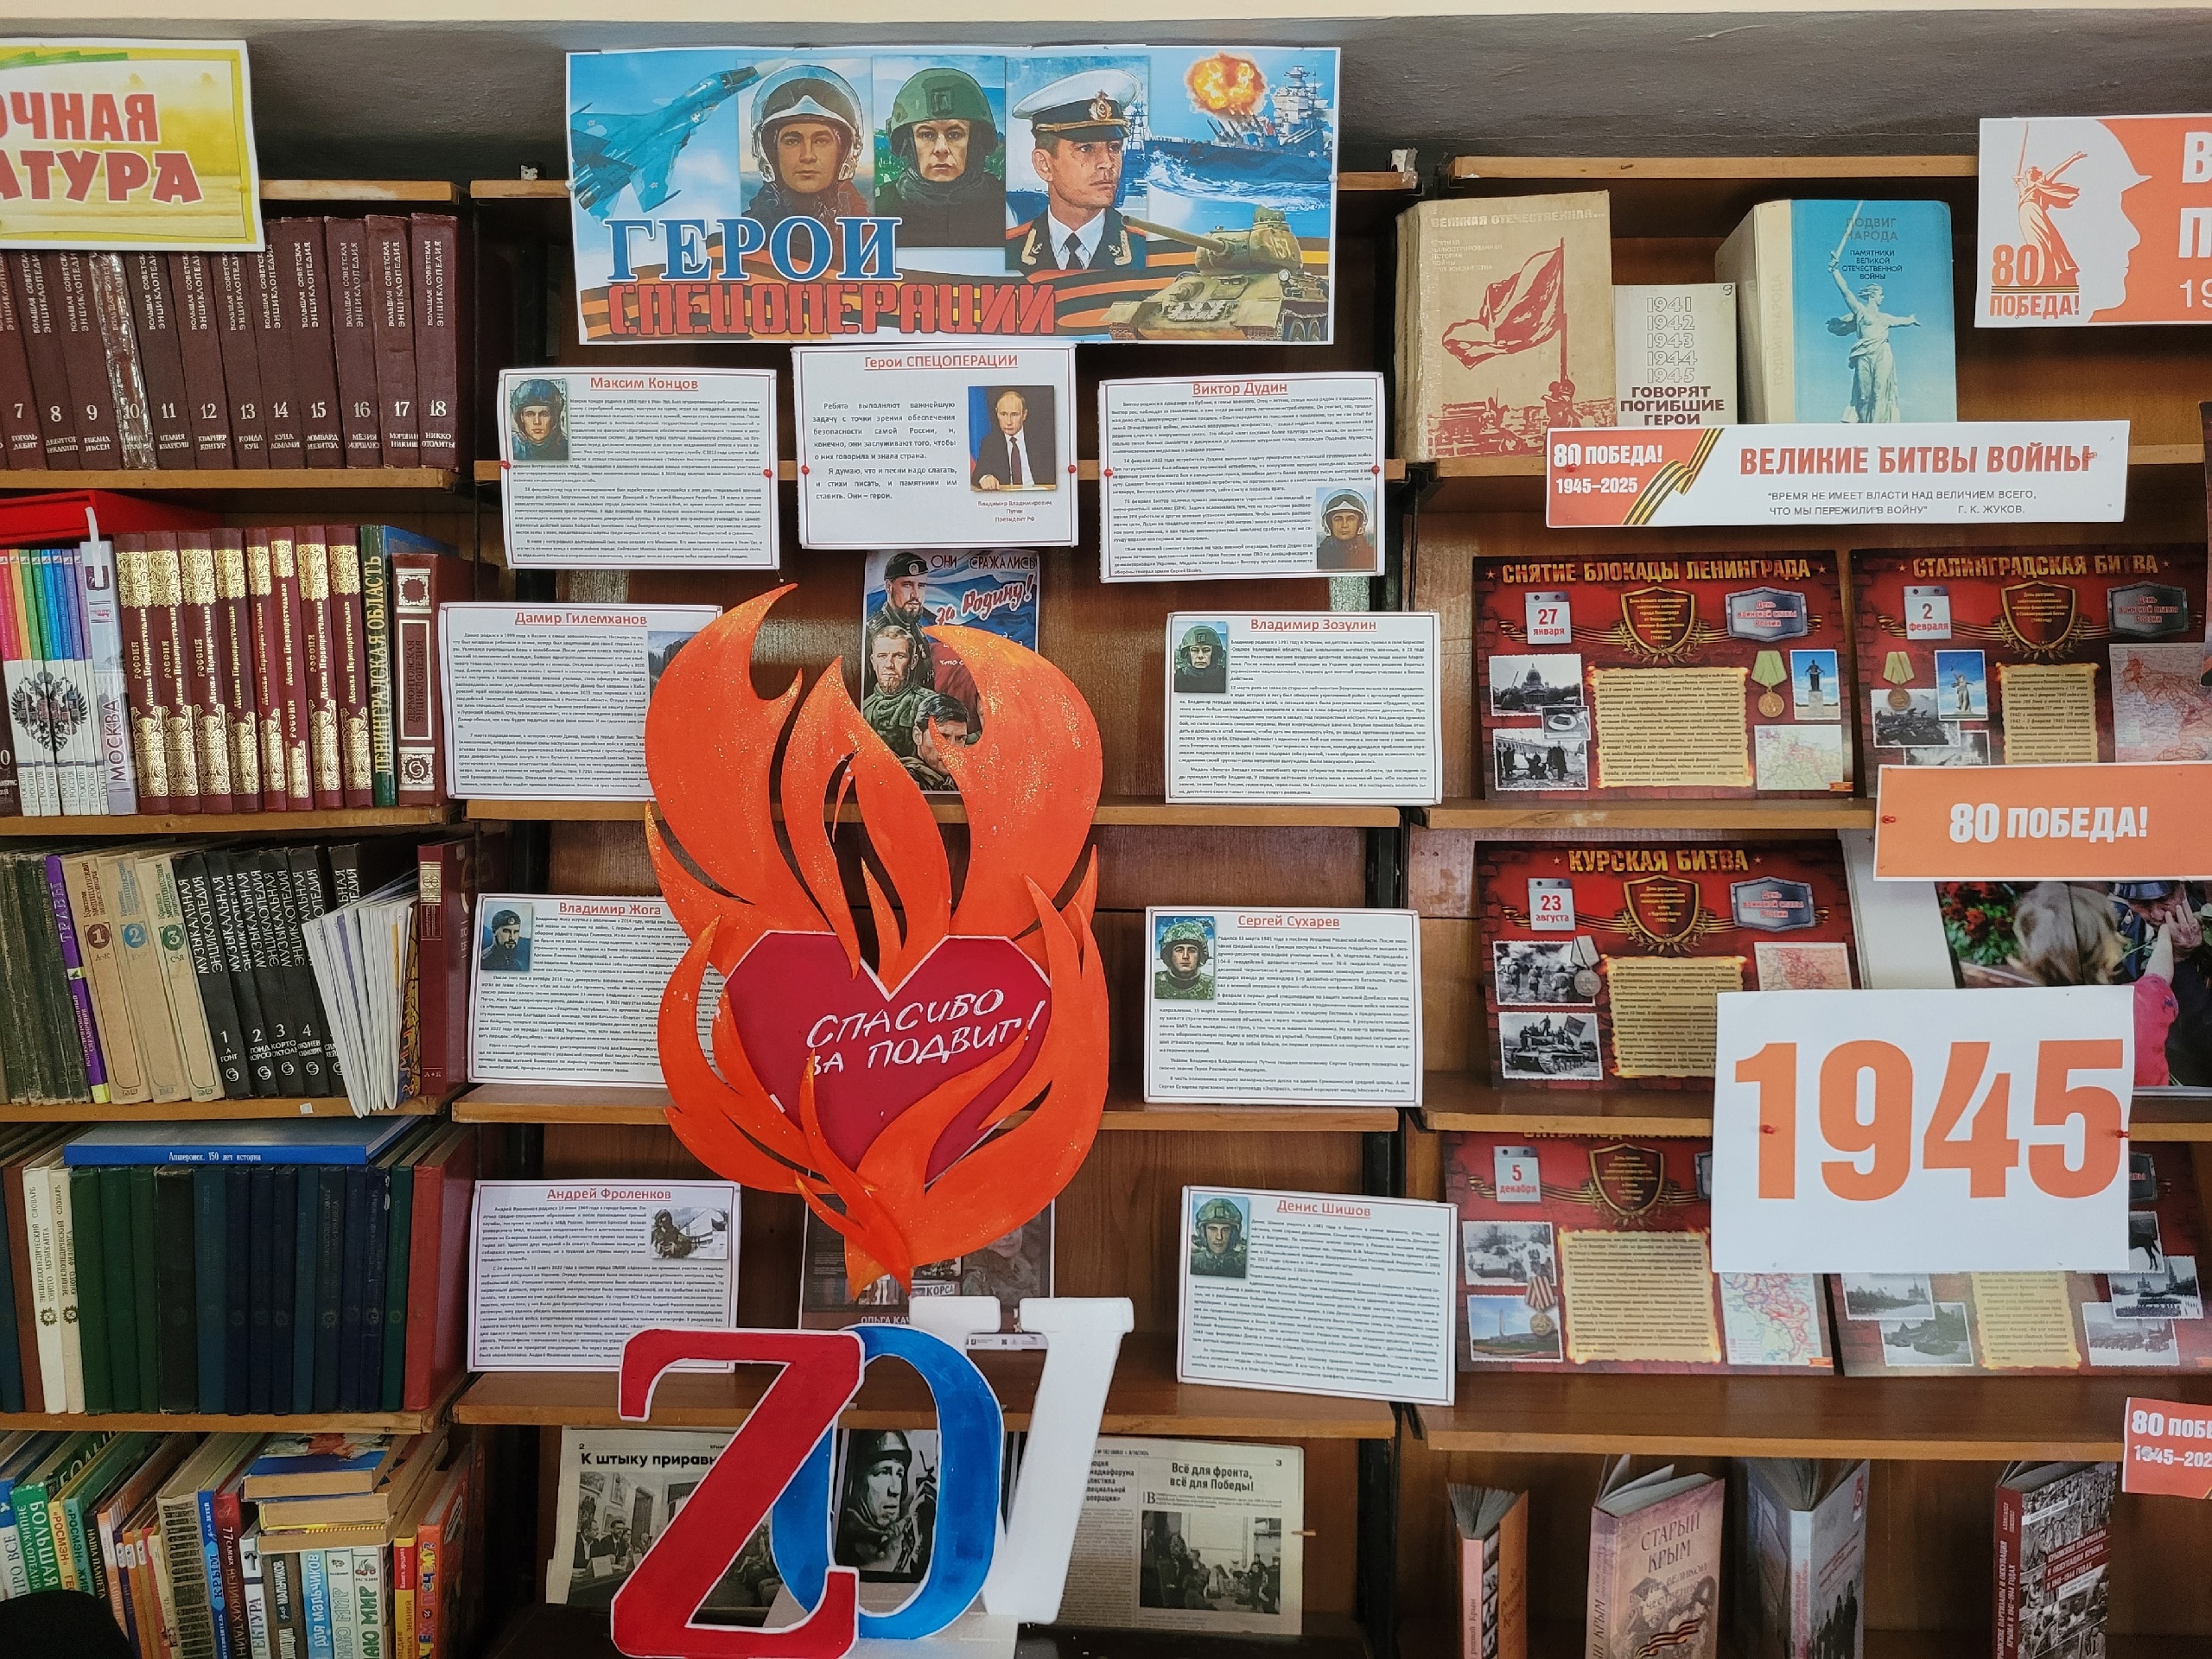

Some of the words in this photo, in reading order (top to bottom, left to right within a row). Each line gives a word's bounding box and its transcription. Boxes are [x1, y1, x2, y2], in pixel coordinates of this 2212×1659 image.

[0, 92, 159, 142] ЧНАЯ
[1430, 215, 1488, 228] ВЕЛИКАЯ
[603, 216, 904, 281] ГЕРОИ
[1992, 244, 2040, 286] 80
[435, 241, 444, 327] ЭНЦИКЛОПЕДИЯ
[608, 283, 1056, 334] СПЕЦОПЕРАЦИИ
[1647, 296, 1691, 313] 1941
[1990, 295, 2080, 319] ПОБЕДА!
[1647, 315, 1695, 330] 1942
[1647, 333, 1694, 348] 1943
[864, 356, 903, 370] Герои
[906, 354, 1019, 369] СПЕЦОПЕРАЦИИ
[1647, 350, 1698, 365] 1944
[590, 376, 645, 391] Максим
[648, 377, 699, 392] Концов
[1647, 367, 1695, 383] 1945
[1192, 381, 1241, 395] Виктор
[1245, 381, 1288, 396] Дудин
[1631, 385, 1712, 398] ГОВОРЯТ
[14, 403, 24, 419] 7
[50, 405, 61, 423] 8
[86, 404, 98, 421] 9
[162, 402, 176, 419] 11
[200, 403, 217, 420] 12
[240, 404, 257, 420] 13
[273, 402, 289, 418] 14
[311, 402, 327, 418] 15
[353, 402, 371, 418] 16
[394, 401, 410, 416] 17
[429, 400, 447, 416] 18
[1620, 399, 1726, 412] ПОГИБШИЕ
[1644, 414, 1700, 425] ГЕРОИ
[1554, 443, 1581, 468] 80
[1585, 444, 1662, 466] ПОБЕДА!
[1740, 446, 1869, 475] ВЕЛИКИЕ
[1878, 445, 1978, 474] БИТВЫ
[1986, 442, 2091, 473] ВОЙНЫ
[1812, 492, 1826, 500] НЕ
[1828, 491, 1863, 500] ИМЕЕТ
[1866, 491, 1909, 500] ВЛАСТИ
[1911, 491, 1933, 501] НАД
[1936, 490, 1994, 499] ВЕЛИЧИЕМ
[1999, 490, 2037, 501] ВСЕГО,
[1770, 506, 1791, 516] ЧТО
[1795, 506, 1812, 516] МЫ
[1815, 505, 1873, 515] ПЕРЕЖИЛИ
[1887, 505, 1928, 514] ВОЙНУ"
[1983, 505, 2025, 514] ЖУКОВ.
[931, 555, 958, 569] ОНИ
[969, 556, 1037, 570] СРАЖАЛИСЬ
[1502, 563, 1576, 583] СНЯТИЕ
[1584, 561, 1679, 582] БЛОКАДЫ
[1686, 559, 1811, 581] ЛЕНИНГРАДА
[1912, 555, 2088, 579] СТАЛИНГРАДСКАЯ
[364, 556, 386, 630] ОБЛАСТЬ
[962, 574, 1034, 620] Родину!
[282, 584, 293, 654] Первопрестольная
[516, 612, 562, 627] Дамир
[565, 611, 648, 626] Гилемханов
[1537, 608, 1558, 625] 27
[1922, 603, 1933, 620] 2
[1250, 619, 1319, 632] Владимир
[1322, 619, 1376, 632] Зозулин
[1533, 626, 1565, 638] января
[1909, 621, 1950, 632] февраля
[140, 608, 152, 677] Первопрестольная
[407, 640, 416, 723] ЛЕРМОНТОВСКАЯ
[368, 635, 391, 774] ЛЕНИНГРАДСКАЯ
[103, 698, 127, 783] МОСКВА
[1950, 804, 2000, 843] 80
[2006, 806, 2148, 843] ПОБЕДА!
[1569, 849, 1669, 873] КУРСКАЯ
[1676, 849, 1749, 872] БИТВА
[50, 882, 73, 943] ТРАВЫ
[559, 901, 626, 916] Владимир
[629, 901, 662, 916] Жога
[1540, 895, 1561, 912] 23
[178, 879, 210, 974] МУЗЫКАЛЬНАЯ
[192, 876, 223, 974] ЭНЦИКЛОПЕДИЯ
[264, 872, 292, 968] МУЗЫКАЛЬНАЯ
[276, 869, 305, 967] ЭНЦИКЛОПЕДИЯ
[1237, 915, 1283, 930] Сергей
[1287, 915, 1340, 930] Сухарев
[1535, 913, 1569, 924] августа
[302, 1023, 312, 1037] 4
[806, 988, 1004, 1049] СПАСИБО
[220, 1030, 228, 1043] 1
[251, 1029, 263, 1042] 2
[276, 1024, 286, 1037] 3
[868, 1000, 1046, 1071] ПОДВИГ!
[1735, 1039, 2123, 1201] 1945
[208, 1152, 219, 1161] 150
[236, 1153, 261, 1161] истории
[1512, 1164, 1522, 1181] 5
[547, 1186, 595, 1201] Андрей
[599, 1186, 671, 1200] Фроленков
[1499, 1184, 1537, 1196] декабря
[29, 1186, 39, 1218] СЛОВАРЬ
[1277, 1199, 1319, 1215] Денис
[1322, 1202, 1371, 1217] Шишов
[43, 1227, 54, 1270] МУЗЫКАНТА
[32, 1224, 45, 1303] ЭНЦИКЛОПЕДИЧЕСКИЙ
[46, 1275, 54, 1302] ЮНОГО
[2132, 1410, 2164, 1436] 80
[582, 1453, 592, 1465] К
[596, 1455, 648, 1467] штыку
[1172, 1463, 1190, 1474] Всё
[1192, 1465, 1211, 1476] для
[1213, 1466, 1253, 1479] фронта,
[1170, 1476, 1187, 1486] всё
[1189, 1478, 1208, 1490] для
[1211, 1478, 1254, 1492] Победы!
[87, 1529, 99, 1555] НАША
[222, 1526, 234, 1541] 77
[1641, 1511, 1700, 1552] СТАРЫЙ
[3, 1535, 20, 1561] ВСЕ
[16, 1505, 41, 1590] ЭНЦИКЛОПЕДИЯ
[29, 1501, 59, 1587] БОЛЬШАЯ
[226, 1540, 234, 1566] САМЫХ
[1648, 1539, 1691, 1573] КРЫМ
[10, 1565, 28, 1596] ПРО
[92, 1555, 107, 1599] ПЛАНЕТА
[210, 1554, 224, 1599] КРЫМ
[273, 1560, 289, 1605] МАЛЬЧИКОВ
[419, 1541, 436, 1605] ПОЧЕМУ?
[226, 1569, 243, 1623] ВЕЛИКИХ
[333, 1587, 352, 1622] МИР
[359, 1586, 378, 1625] МИР
[1469, 1599, 1478, 1622] Крым
[1593, 1599, 1605, 1637] КРЫМ
[232, 1623, 249, 1657] ТАЙН
